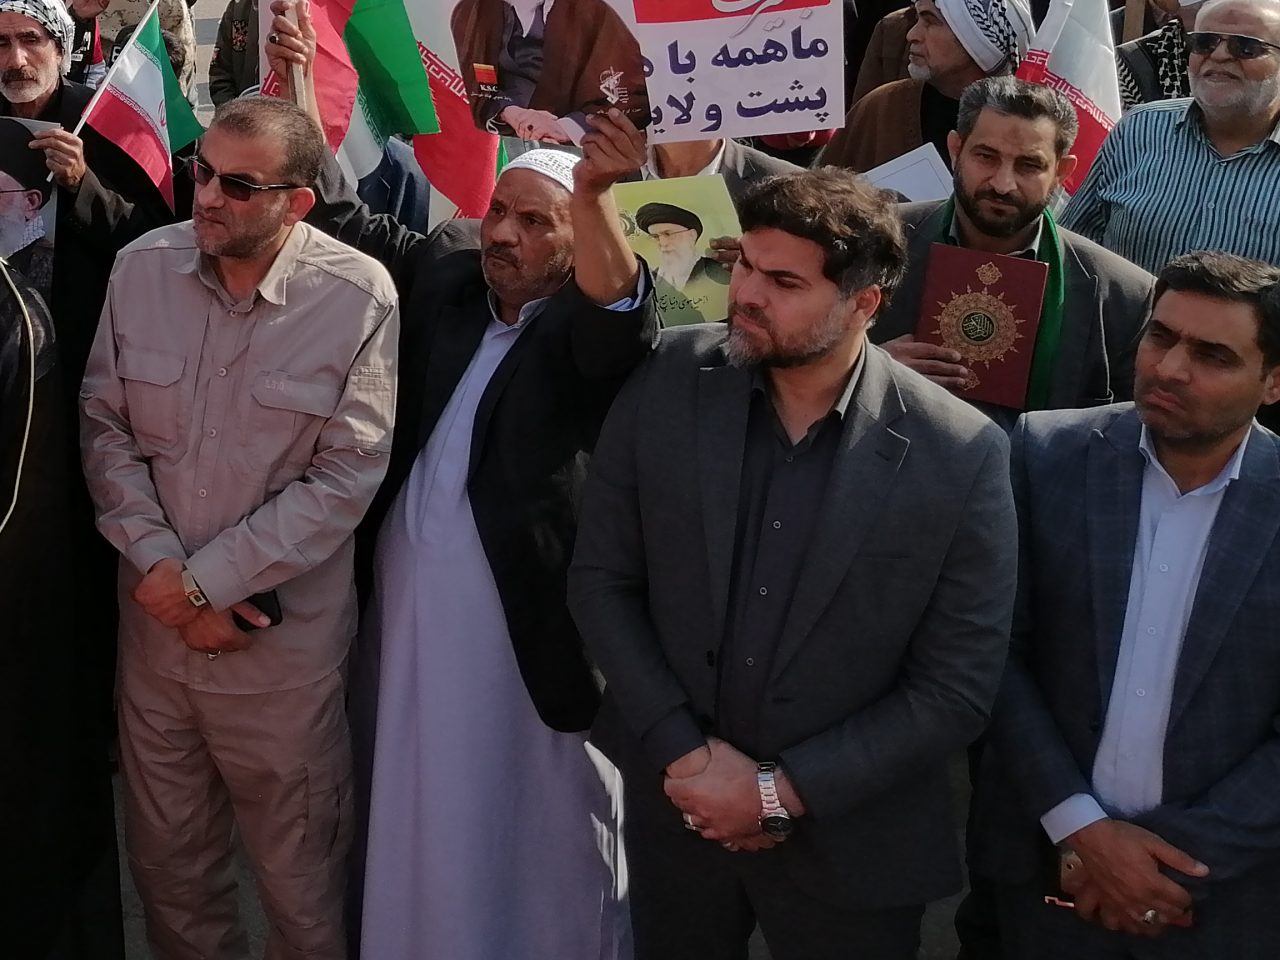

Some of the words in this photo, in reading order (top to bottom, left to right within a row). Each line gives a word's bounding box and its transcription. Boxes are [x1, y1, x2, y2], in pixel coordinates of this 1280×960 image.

[667, 40, 697, 83] با
[711, 38, 788, 69] همه
[650, 91, 723, 134] ولای
[736, 79, 830, 123] پشت
